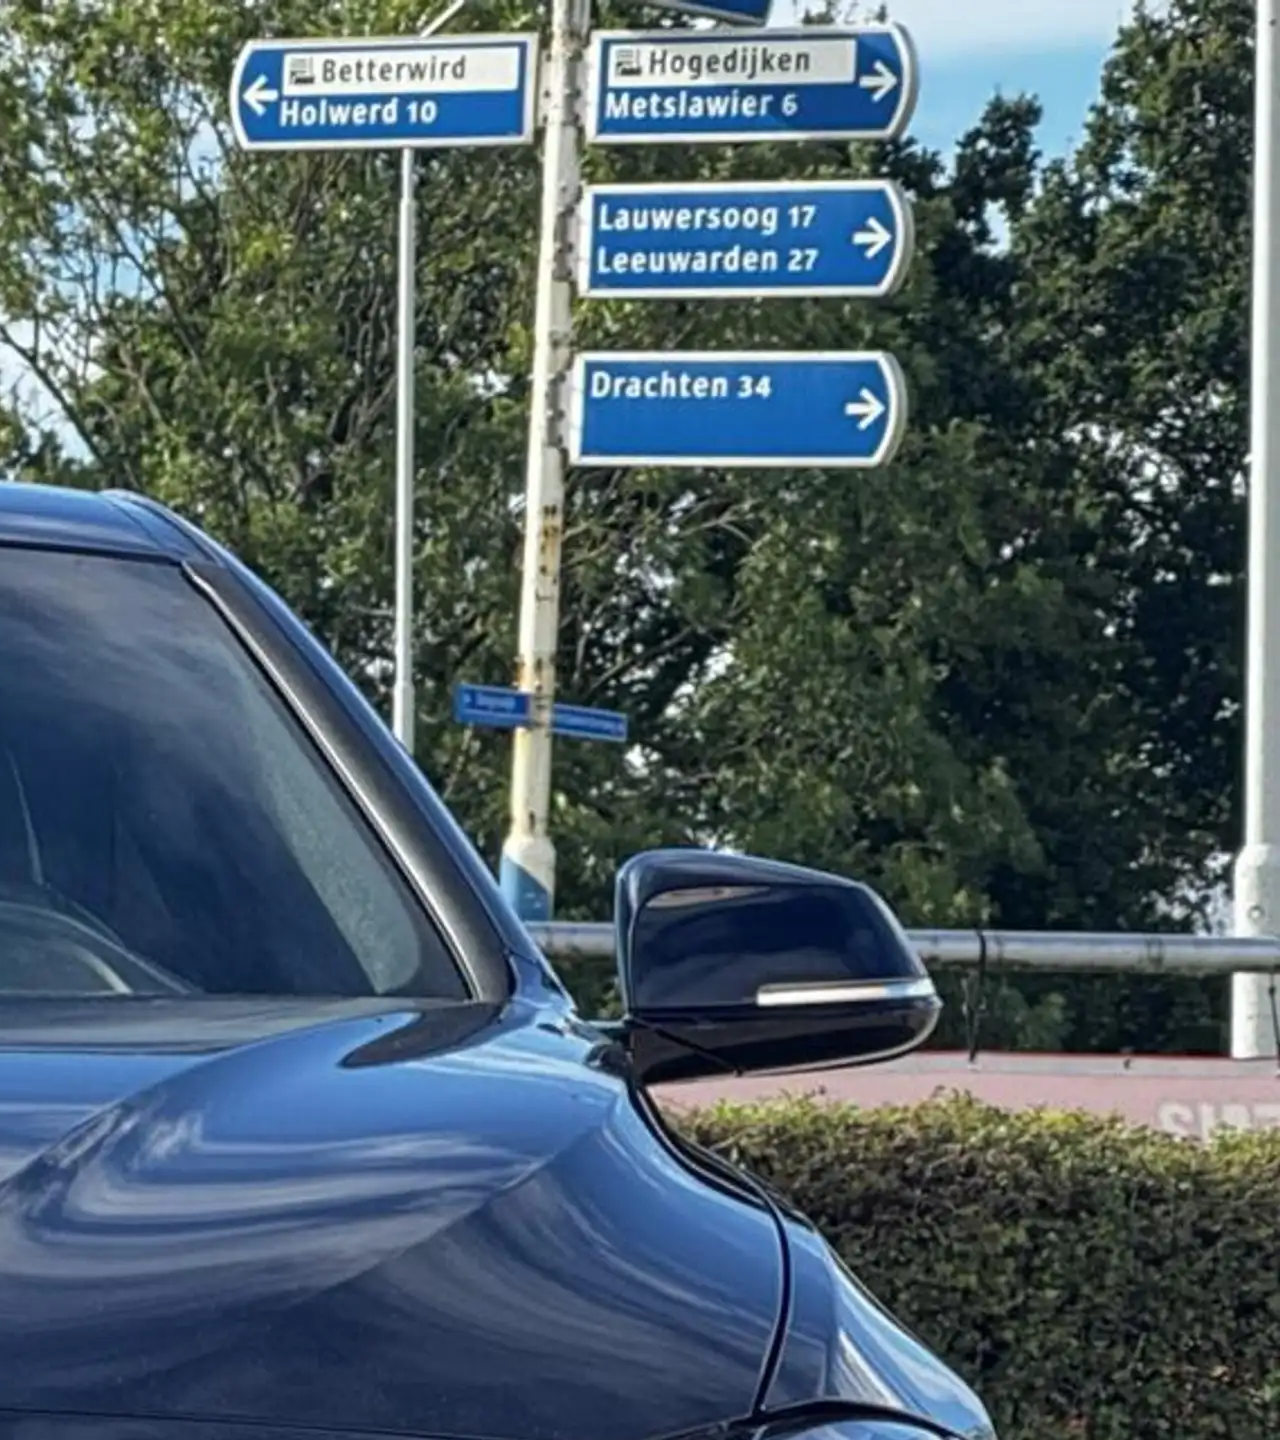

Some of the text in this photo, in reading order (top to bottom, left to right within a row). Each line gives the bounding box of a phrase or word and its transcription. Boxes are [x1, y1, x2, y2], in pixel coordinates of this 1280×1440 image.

[321, 55, 466, 84] Betterwird
[648, 46, 811, 79] Hogedijken
[278, 98, 438, 126] Holwerd 10
[604, 90, 799, 120] Metslawier 6
[598, 203, 816, 236] Lauwersoog 17
[596, 246, 819, 275] Leeuwarden 27
[590, 371, 772, 399] Drachten 34
